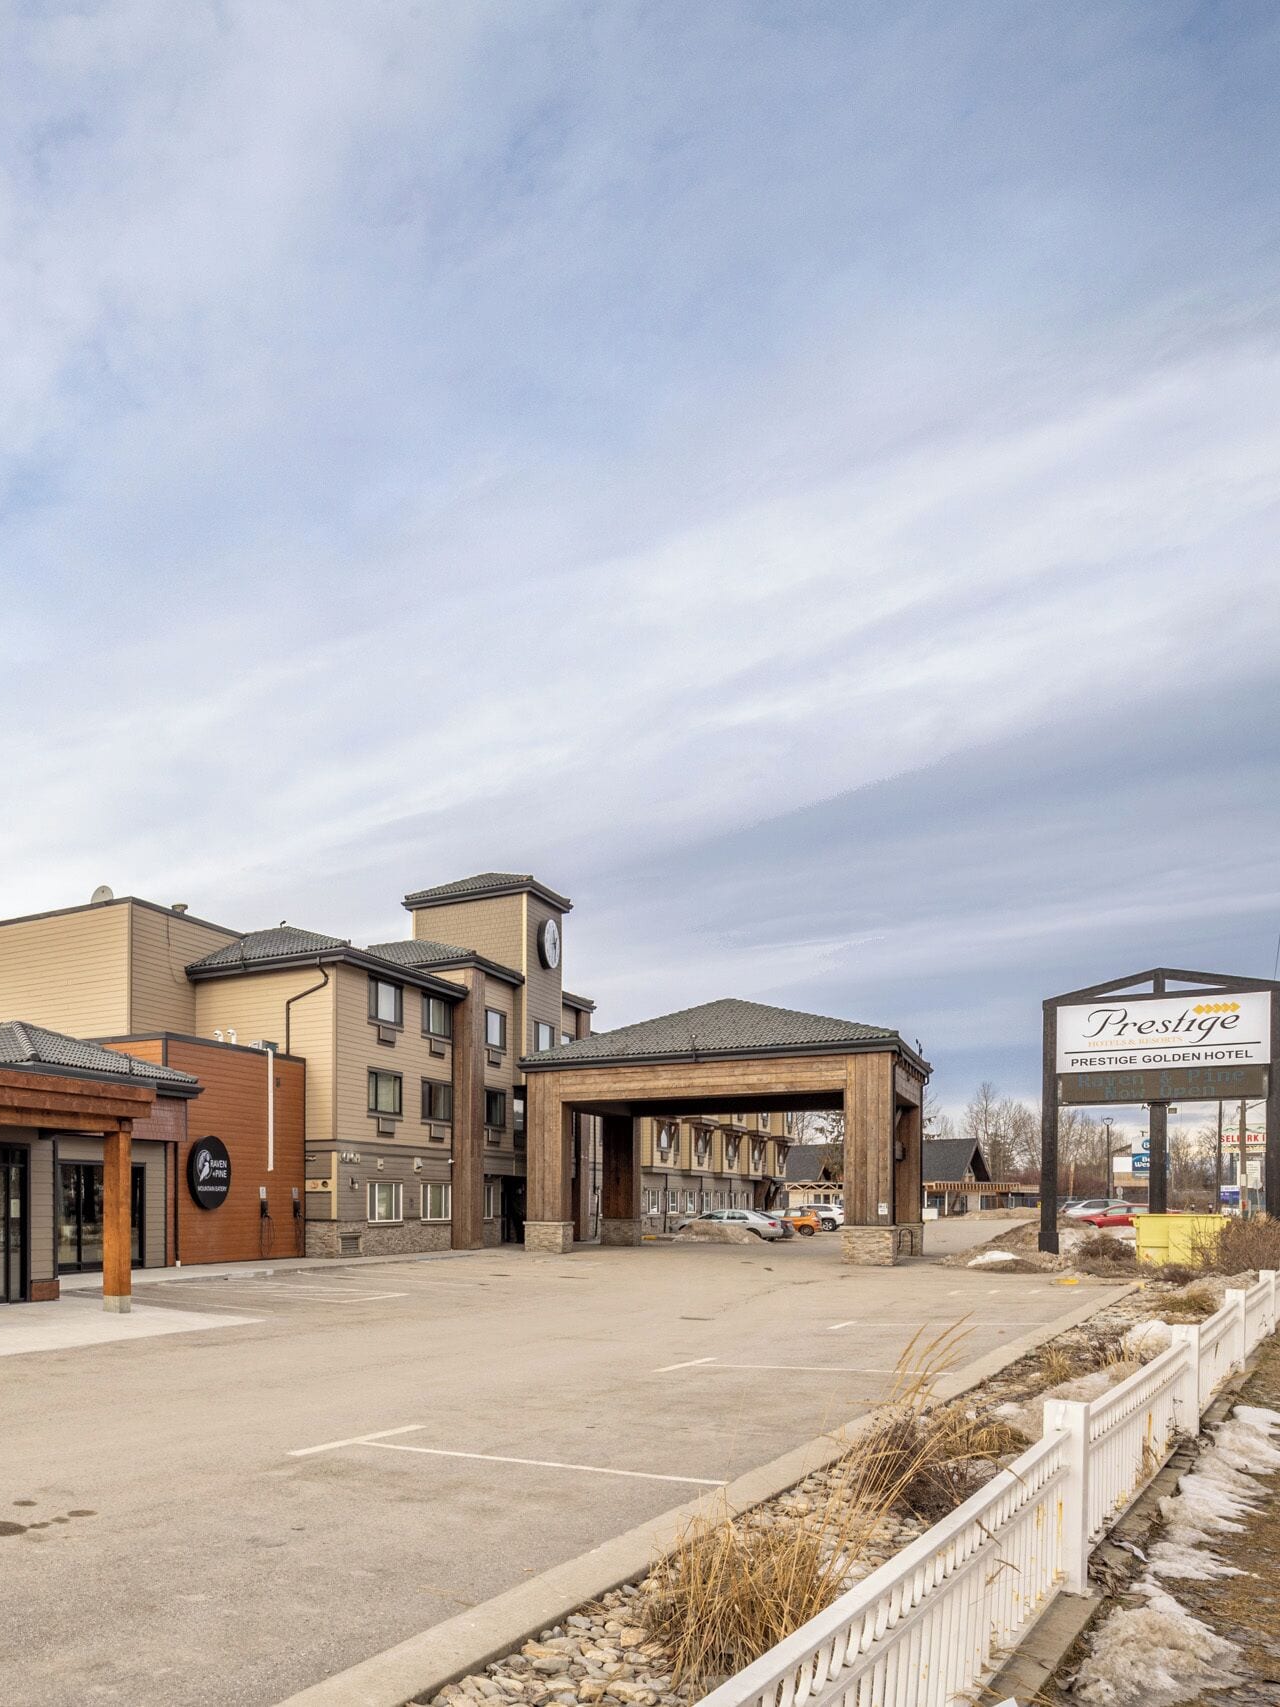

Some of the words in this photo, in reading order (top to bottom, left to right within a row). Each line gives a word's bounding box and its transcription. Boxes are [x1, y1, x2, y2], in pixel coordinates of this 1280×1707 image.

[1081, 1008, 1240, 1043] Prestige
[1088, 1038, 1126, 1048] HOTELS
[1139, 1036, 1184, 1046] RESORTS
[1071, 1055, 1138, 1067] PRESTIGE
[1142, 1052, 1201, 1064] GOLDEN
[1204, 1049, 1253, 1060] HOTEL
[1077, 1073, 1144, 1088] Raven
[1187, 1068, 1245, 1083] Pine
[1159, 1084, 1216, 1099] Open
[1220, 1134, 1259, 1143] SELRK
[210, 1160, 227, 1168] RAVEN
